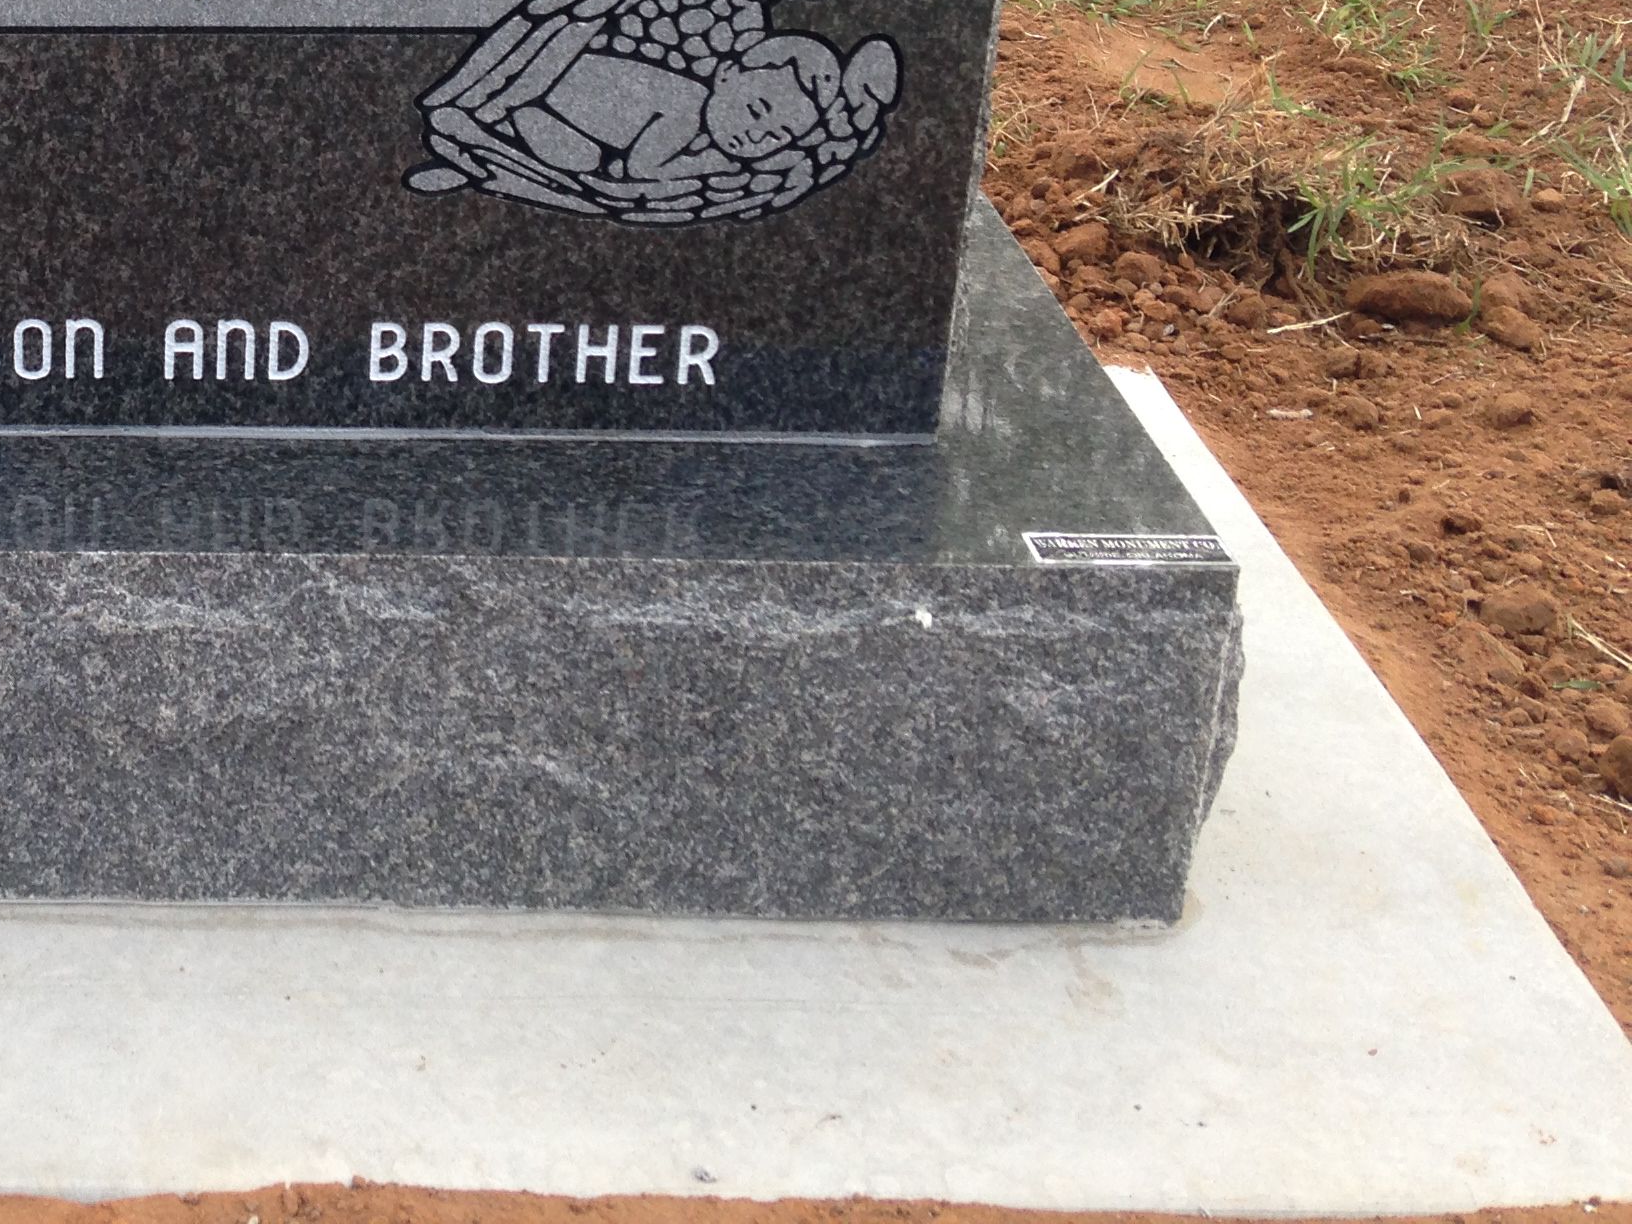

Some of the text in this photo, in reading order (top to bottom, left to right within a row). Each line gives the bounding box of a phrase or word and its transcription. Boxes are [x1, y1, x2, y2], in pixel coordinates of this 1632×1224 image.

[163, 317, 310, 381] AND
[368, 321, 720, 386] BROTHER
[1100, 538, 1190, 549] MONUMENT
